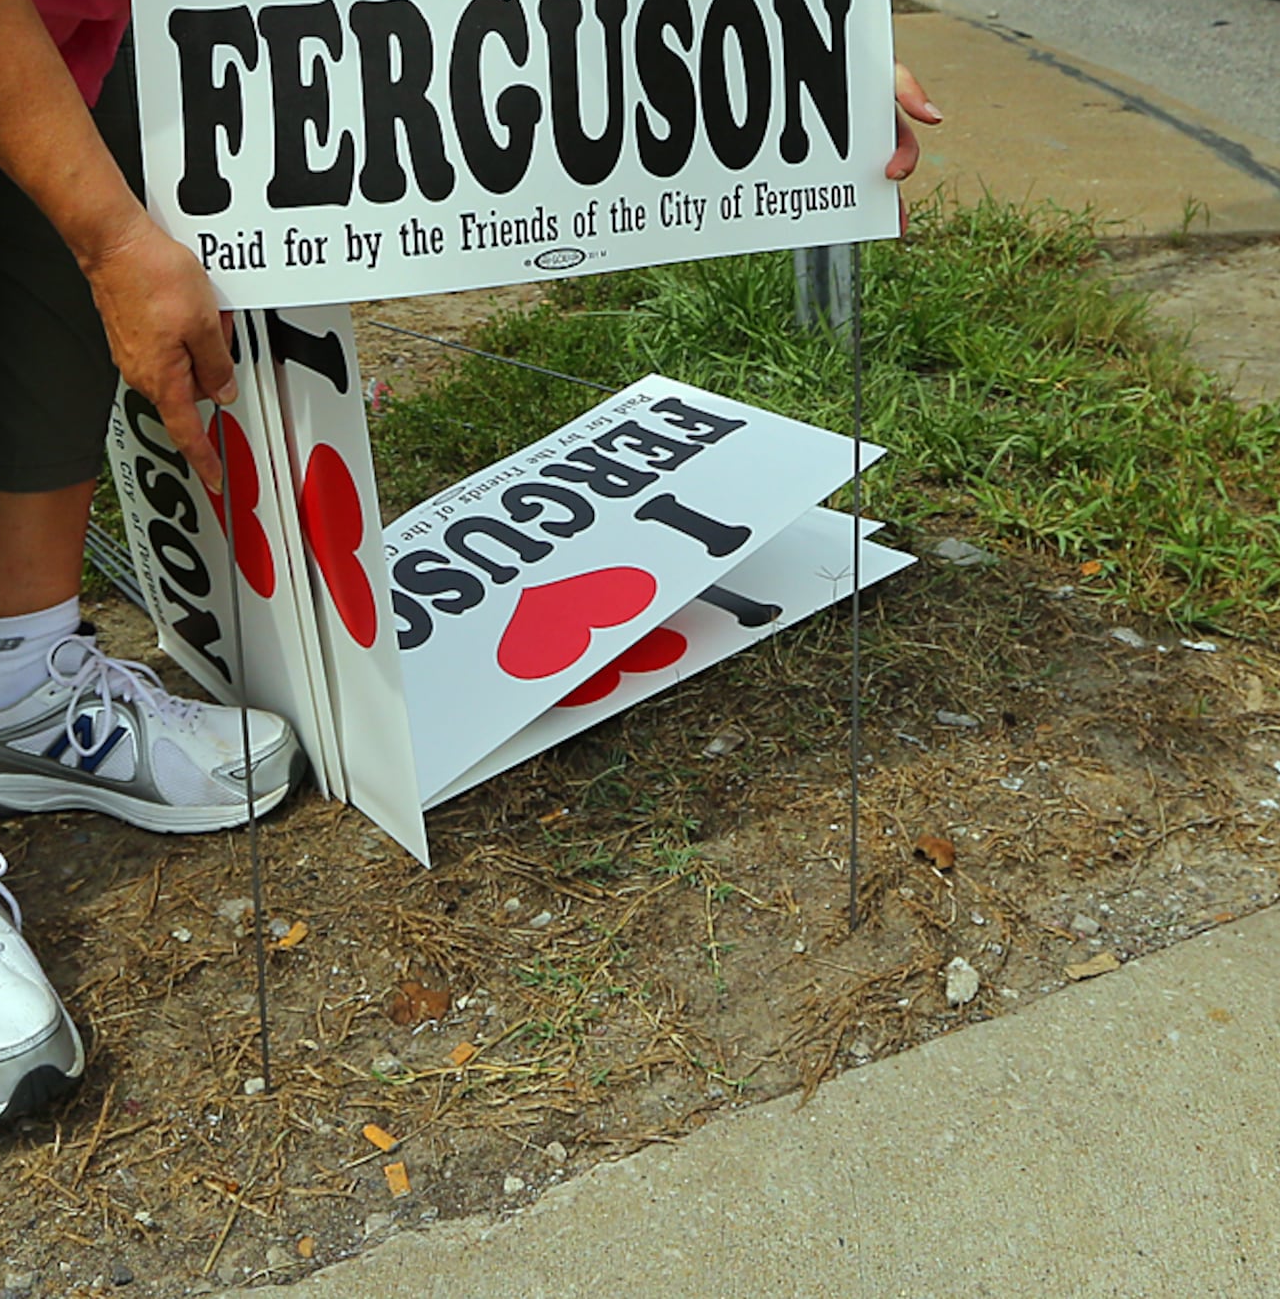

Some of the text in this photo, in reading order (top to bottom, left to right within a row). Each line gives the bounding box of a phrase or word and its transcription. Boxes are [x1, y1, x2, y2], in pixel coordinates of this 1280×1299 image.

[197, 181, 857, 271] Paid for by the Friends of the City of Ferguson
[124, 388, 233, 685] USON
[390, 396, 749, 650] FERGUS
[634, 493, 754, 558] I
